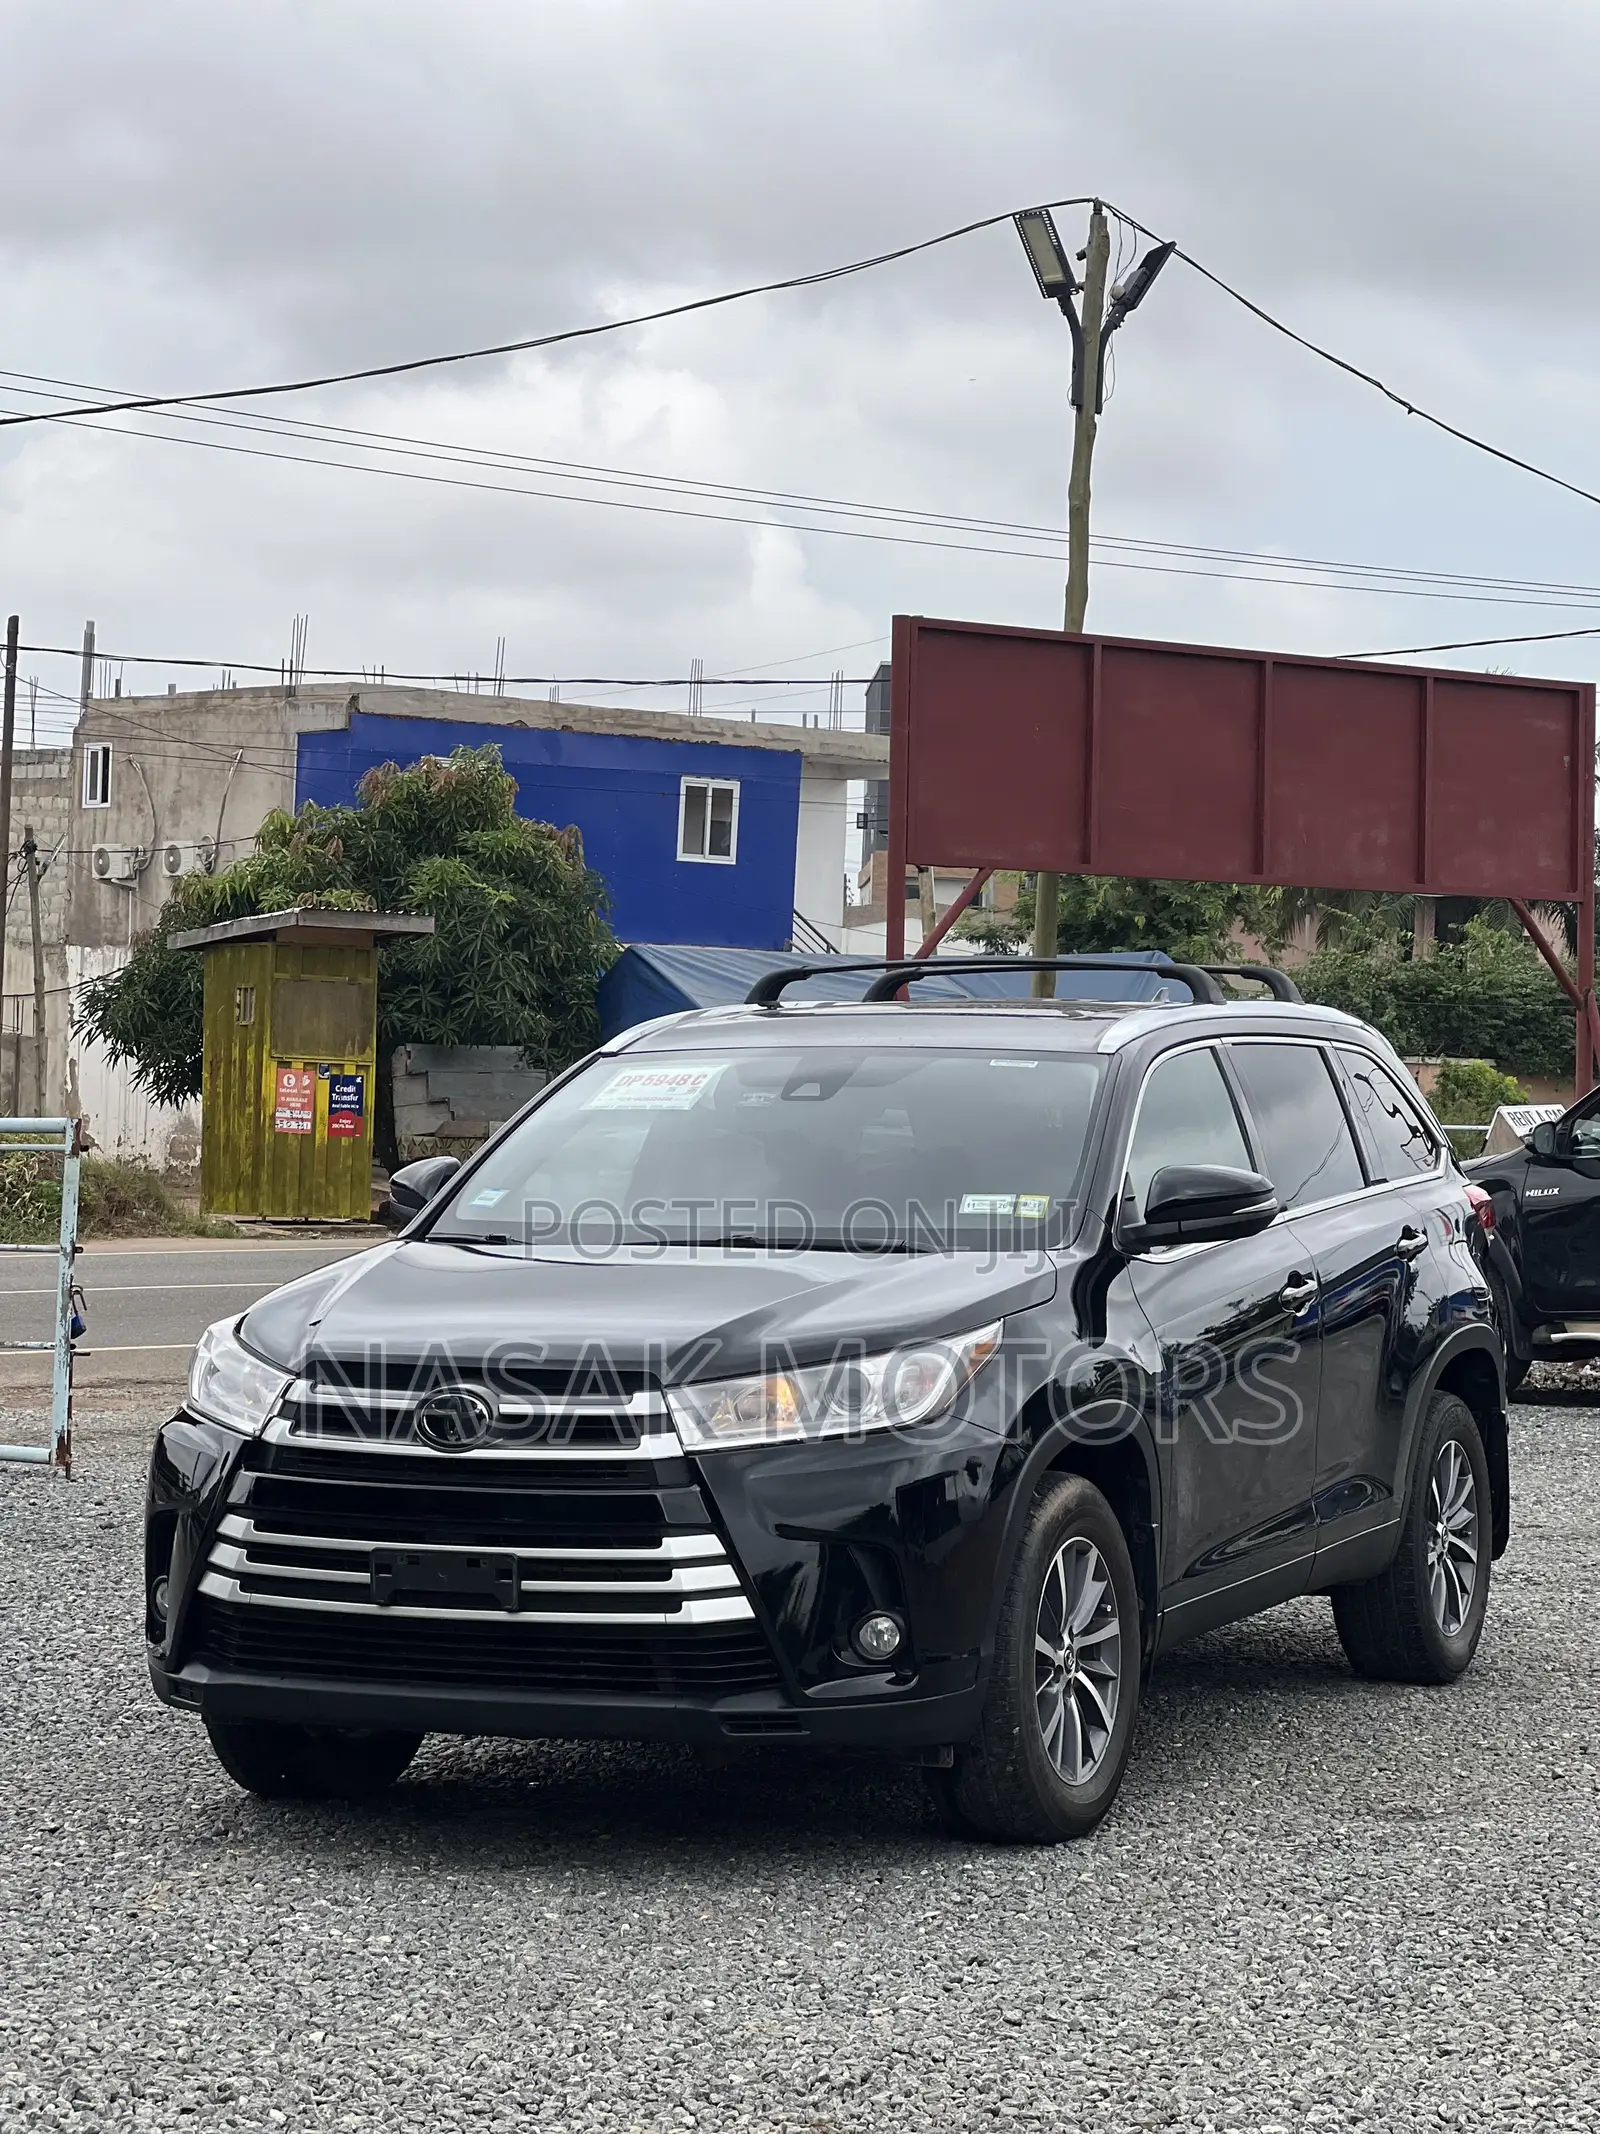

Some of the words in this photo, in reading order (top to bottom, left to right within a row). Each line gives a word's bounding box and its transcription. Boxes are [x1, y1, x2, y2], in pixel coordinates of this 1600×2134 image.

[335, 1085, 356, 1093] Credit
[1506, 1110, 1537, 1127] RENT
[1535, 1109, 1546, 1122] A
[1525, 1187, 1560, 1197] HILUX
